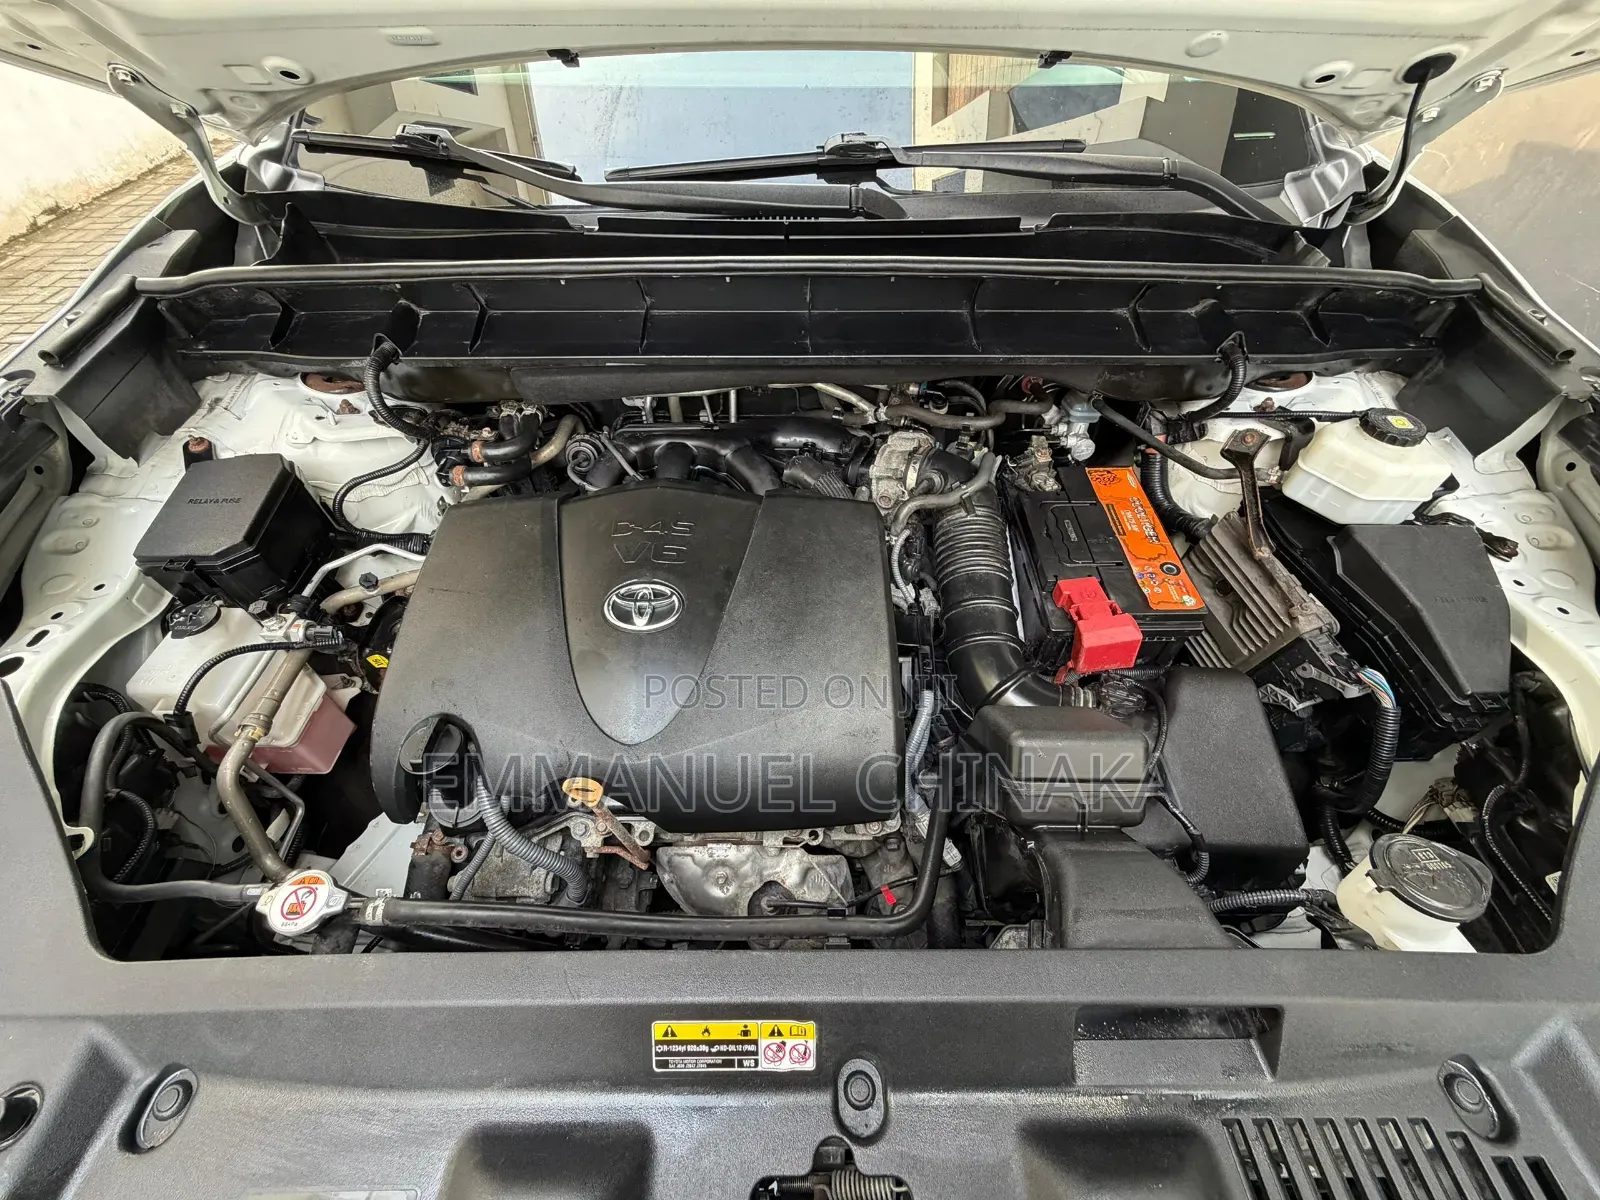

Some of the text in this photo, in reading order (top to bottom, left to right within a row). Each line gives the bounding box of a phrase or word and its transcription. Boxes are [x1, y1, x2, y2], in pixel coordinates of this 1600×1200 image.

[611, 520, 695, 537] D-4S
[613, 540, 688, 564] V6
[743, 1059, 756, 1068] WS
